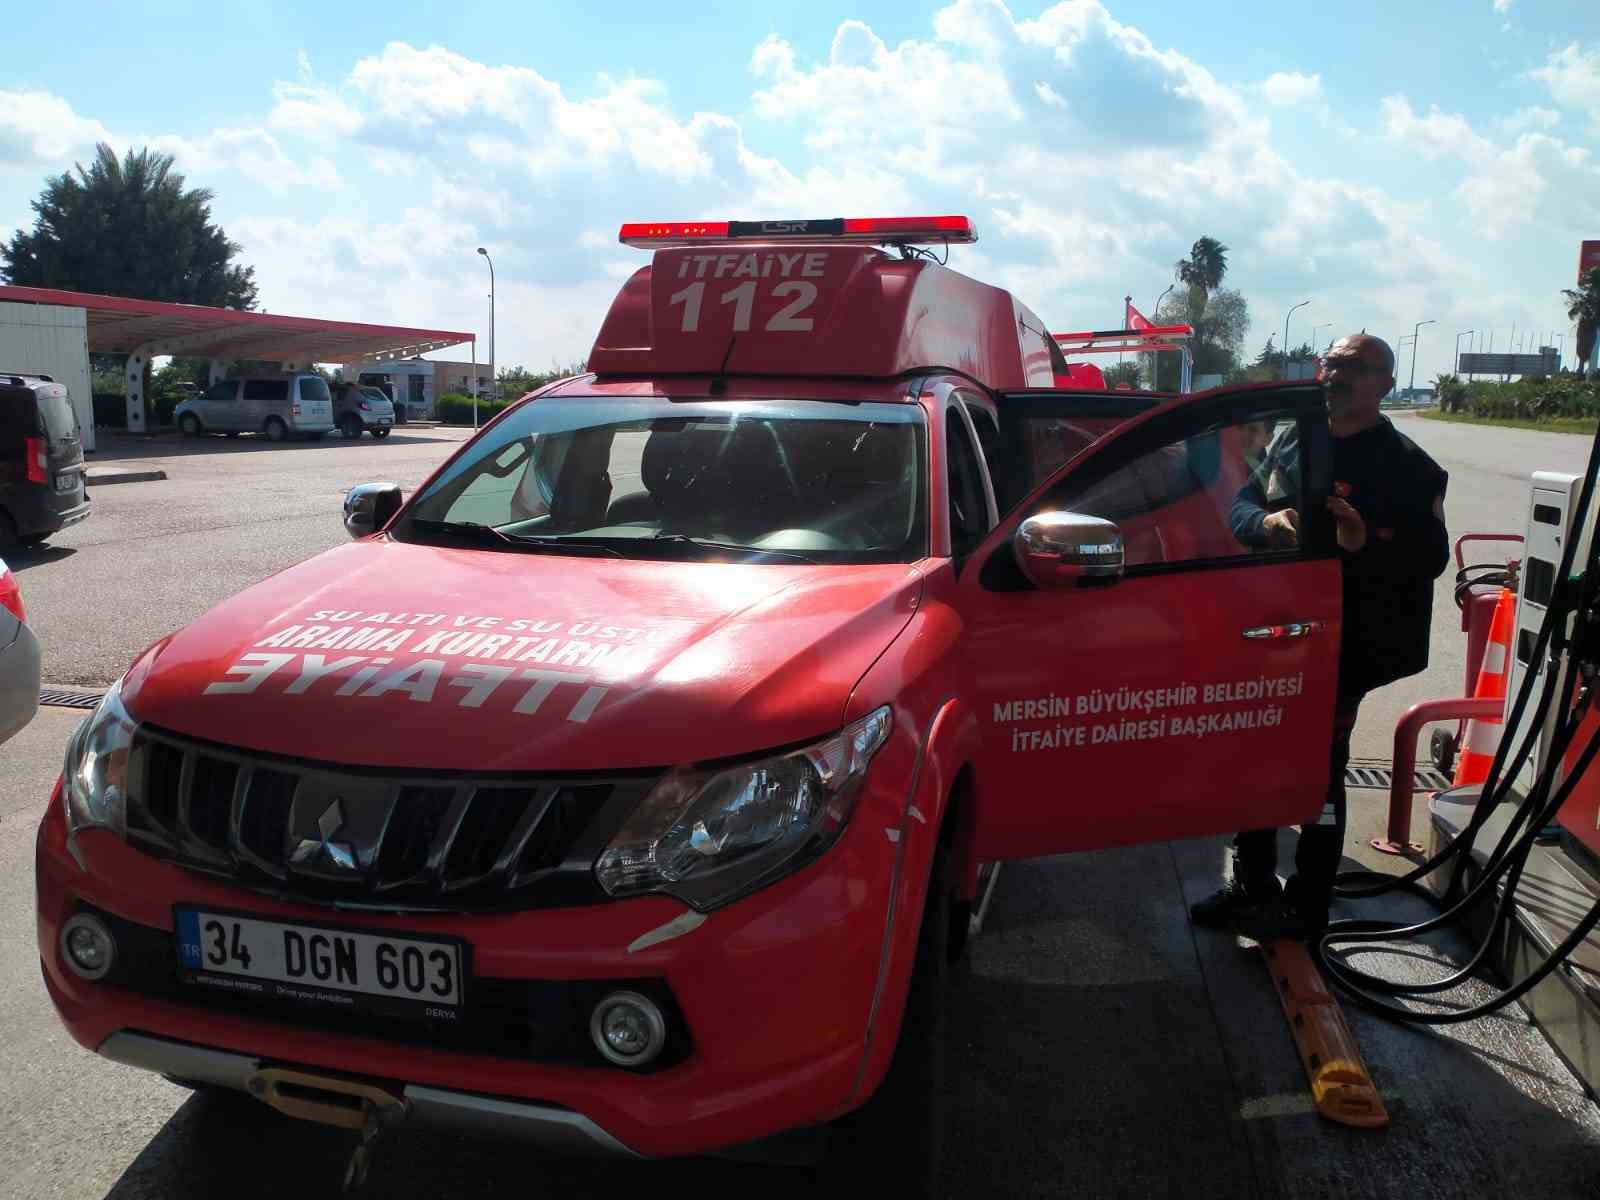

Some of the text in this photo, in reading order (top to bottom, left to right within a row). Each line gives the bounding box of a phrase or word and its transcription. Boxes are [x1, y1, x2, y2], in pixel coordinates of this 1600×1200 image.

[760, 221, 808, 233] CSR
[670, 280, 818, 332] 112
[305, 609, 357, 622] SU
[451, 615, 502, 629] VE
[505, 618, 561, 633] SU
[252, 624, 650, 673] ARAMA KURTARM
[992, 672, 1304, 722] MERSİN BÜYÜKŞEHİR BELEDİYESİ
[1011, 704, 1284, 752] İTFAİYE DAİRESİ BAŞKANLIĞI
[183, 943, 201, 961] TR
[204, 920, 453, 997] 34 DGN 603
